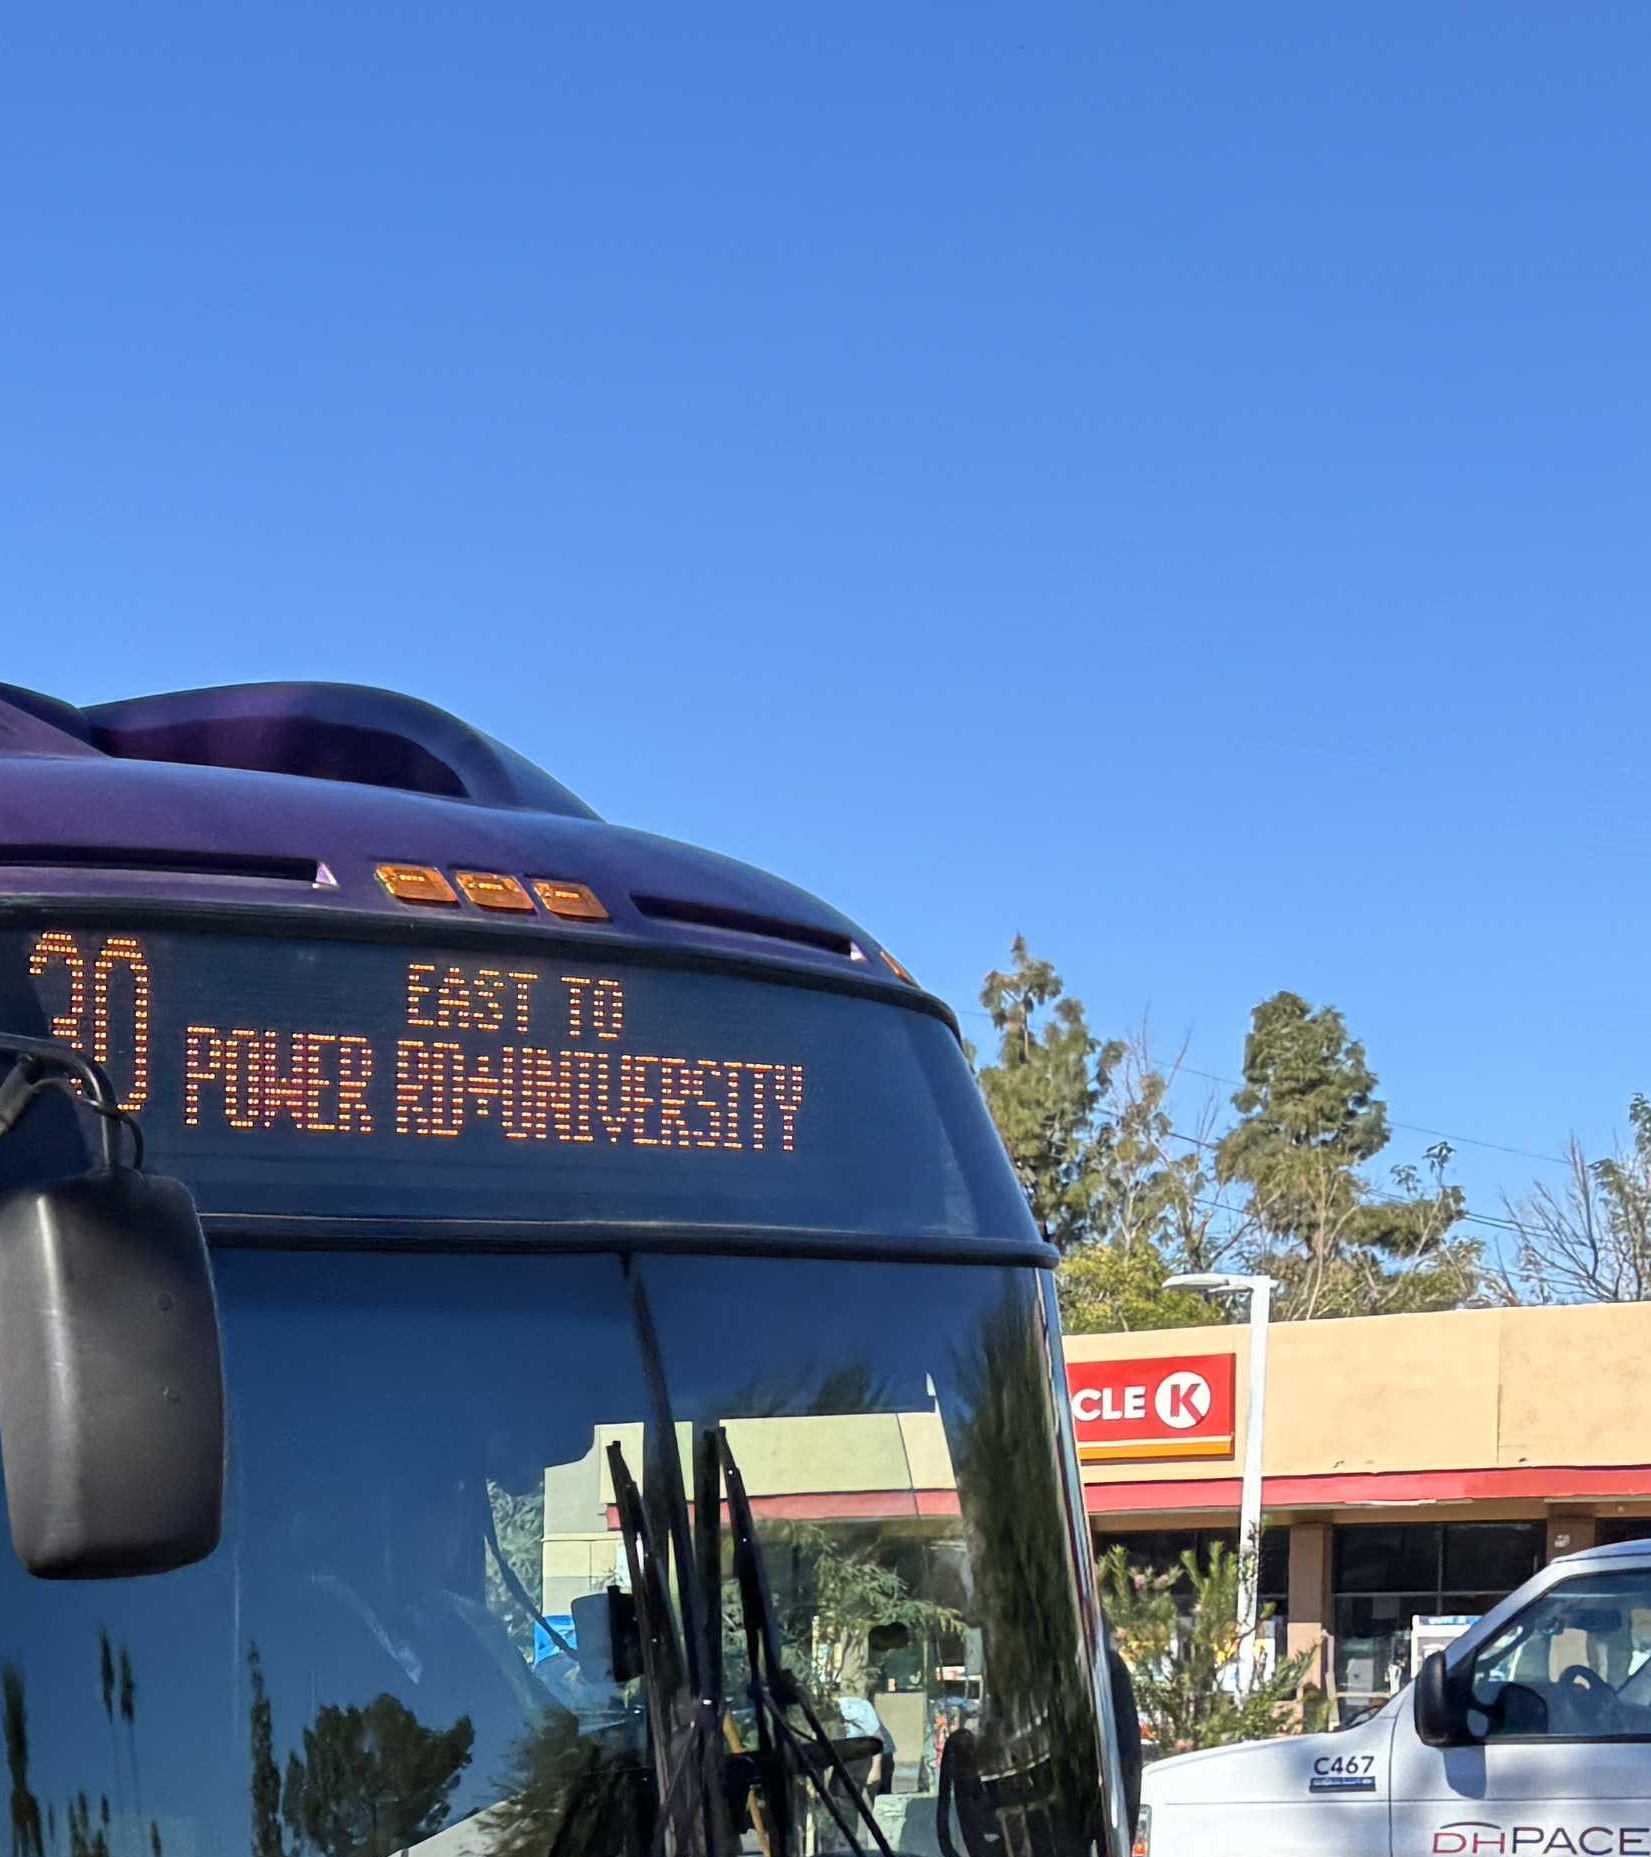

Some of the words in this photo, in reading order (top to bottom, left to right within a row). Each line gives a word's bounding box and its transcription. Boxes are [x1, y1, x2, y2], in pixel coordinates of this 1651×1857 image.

[29, 931, 148, 1112] 30
[408, 963, 539, 1035] EAST
[561, 976, 624, 1040] TO
[185, 1025, 373, 1134] POWER
[1071, 1385, 1147, 1422] CLE
[1170, 1383, 1206, 1426] K
[1314, 1755, 1374, 1775] C467
